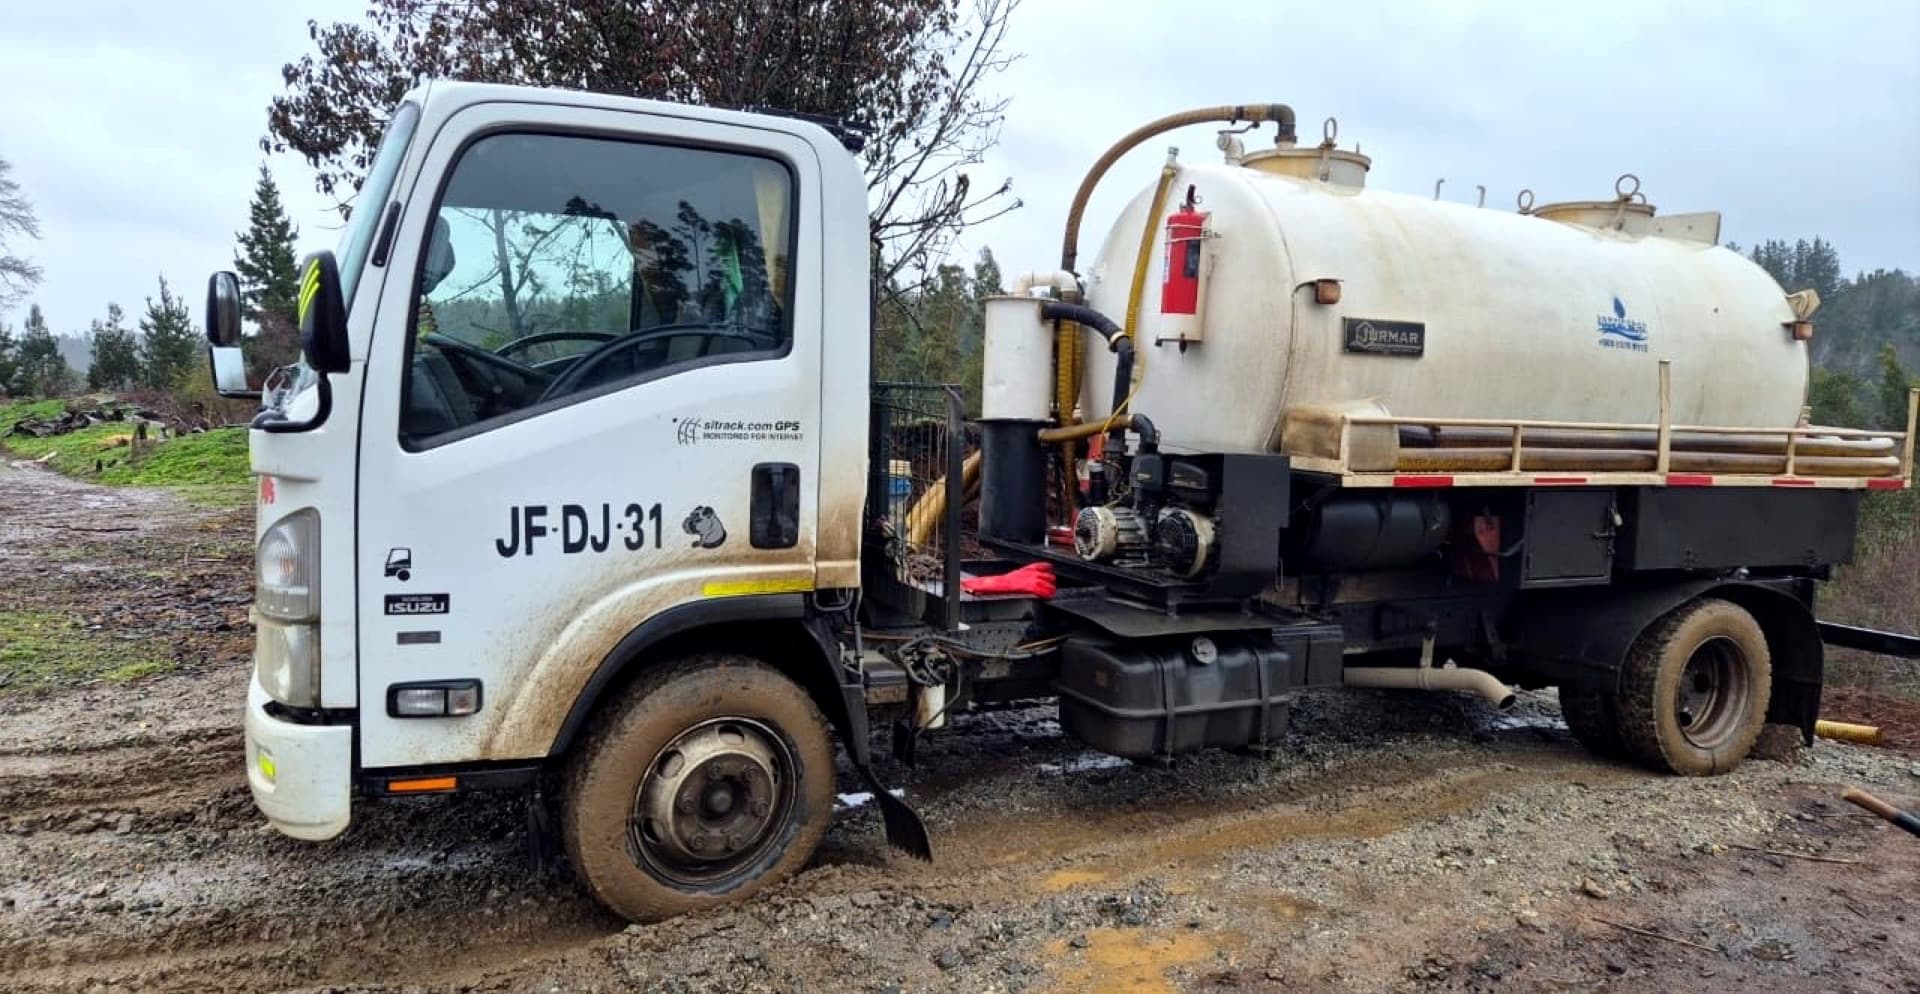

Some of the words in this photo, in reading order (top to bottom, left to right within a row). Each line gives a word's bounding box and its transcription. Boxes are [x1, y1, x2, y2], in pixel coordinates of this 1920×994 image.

[1358, 325, 1418, 345] JURMAR
[703, 420, 772, 431] sitrack.com
[774, 421, 800, 431] GPS
[703, 432, 749, 440] MONITORED
[751, 432, 766, 440] FOR
[768, 432, 803, 441] INTERNET
[389, 601, 445, 613] ISUZU
